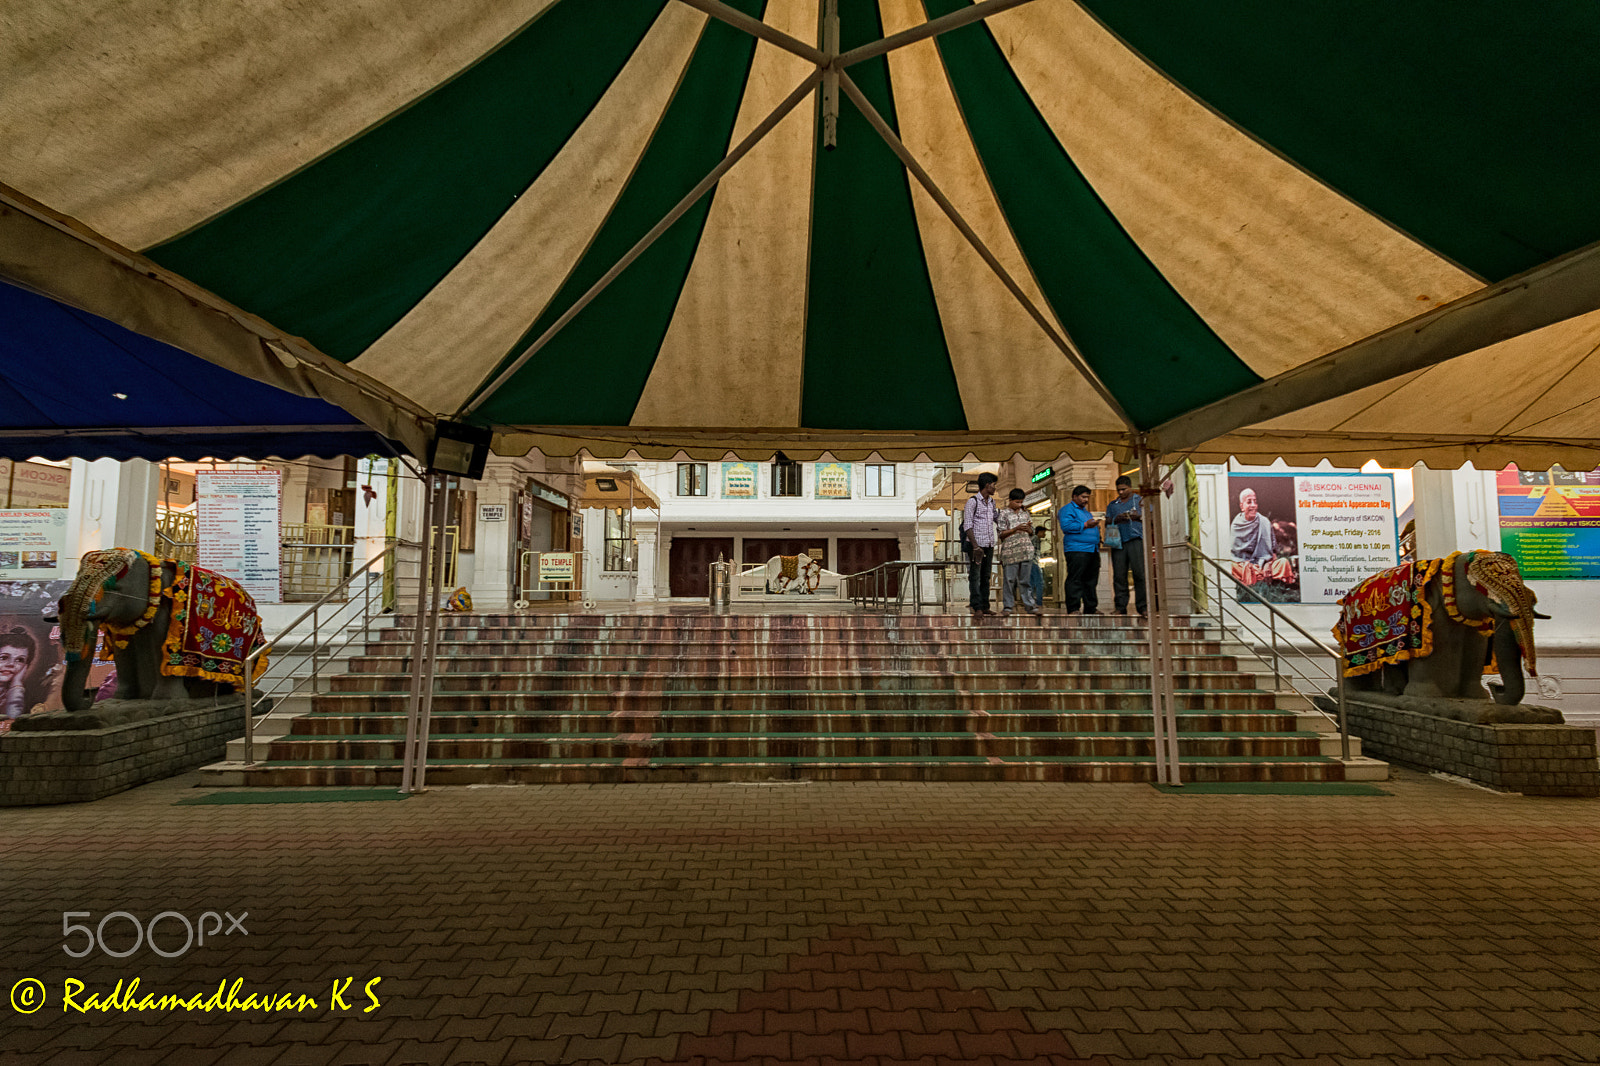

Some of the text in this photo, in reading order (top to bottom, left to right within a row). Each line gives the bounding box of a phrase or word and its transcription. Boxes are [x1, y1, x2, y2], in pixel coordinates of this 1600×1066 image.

[1298, 500, 1390, 510] Srila Prabhupada's Appearance Day
[1310, 514, 1332, 522] (Founder
[1334, 514, 1355, 523] Acharya
[1362, 514, 1385, 522] ISKCON)
[1322, 529, 1343, 538] August,
[1344, 528, 1364, 538] Friday
[1303, 542, 1334, 551] Programme
[1323, 566, 1354, 574] Pushpanjali
